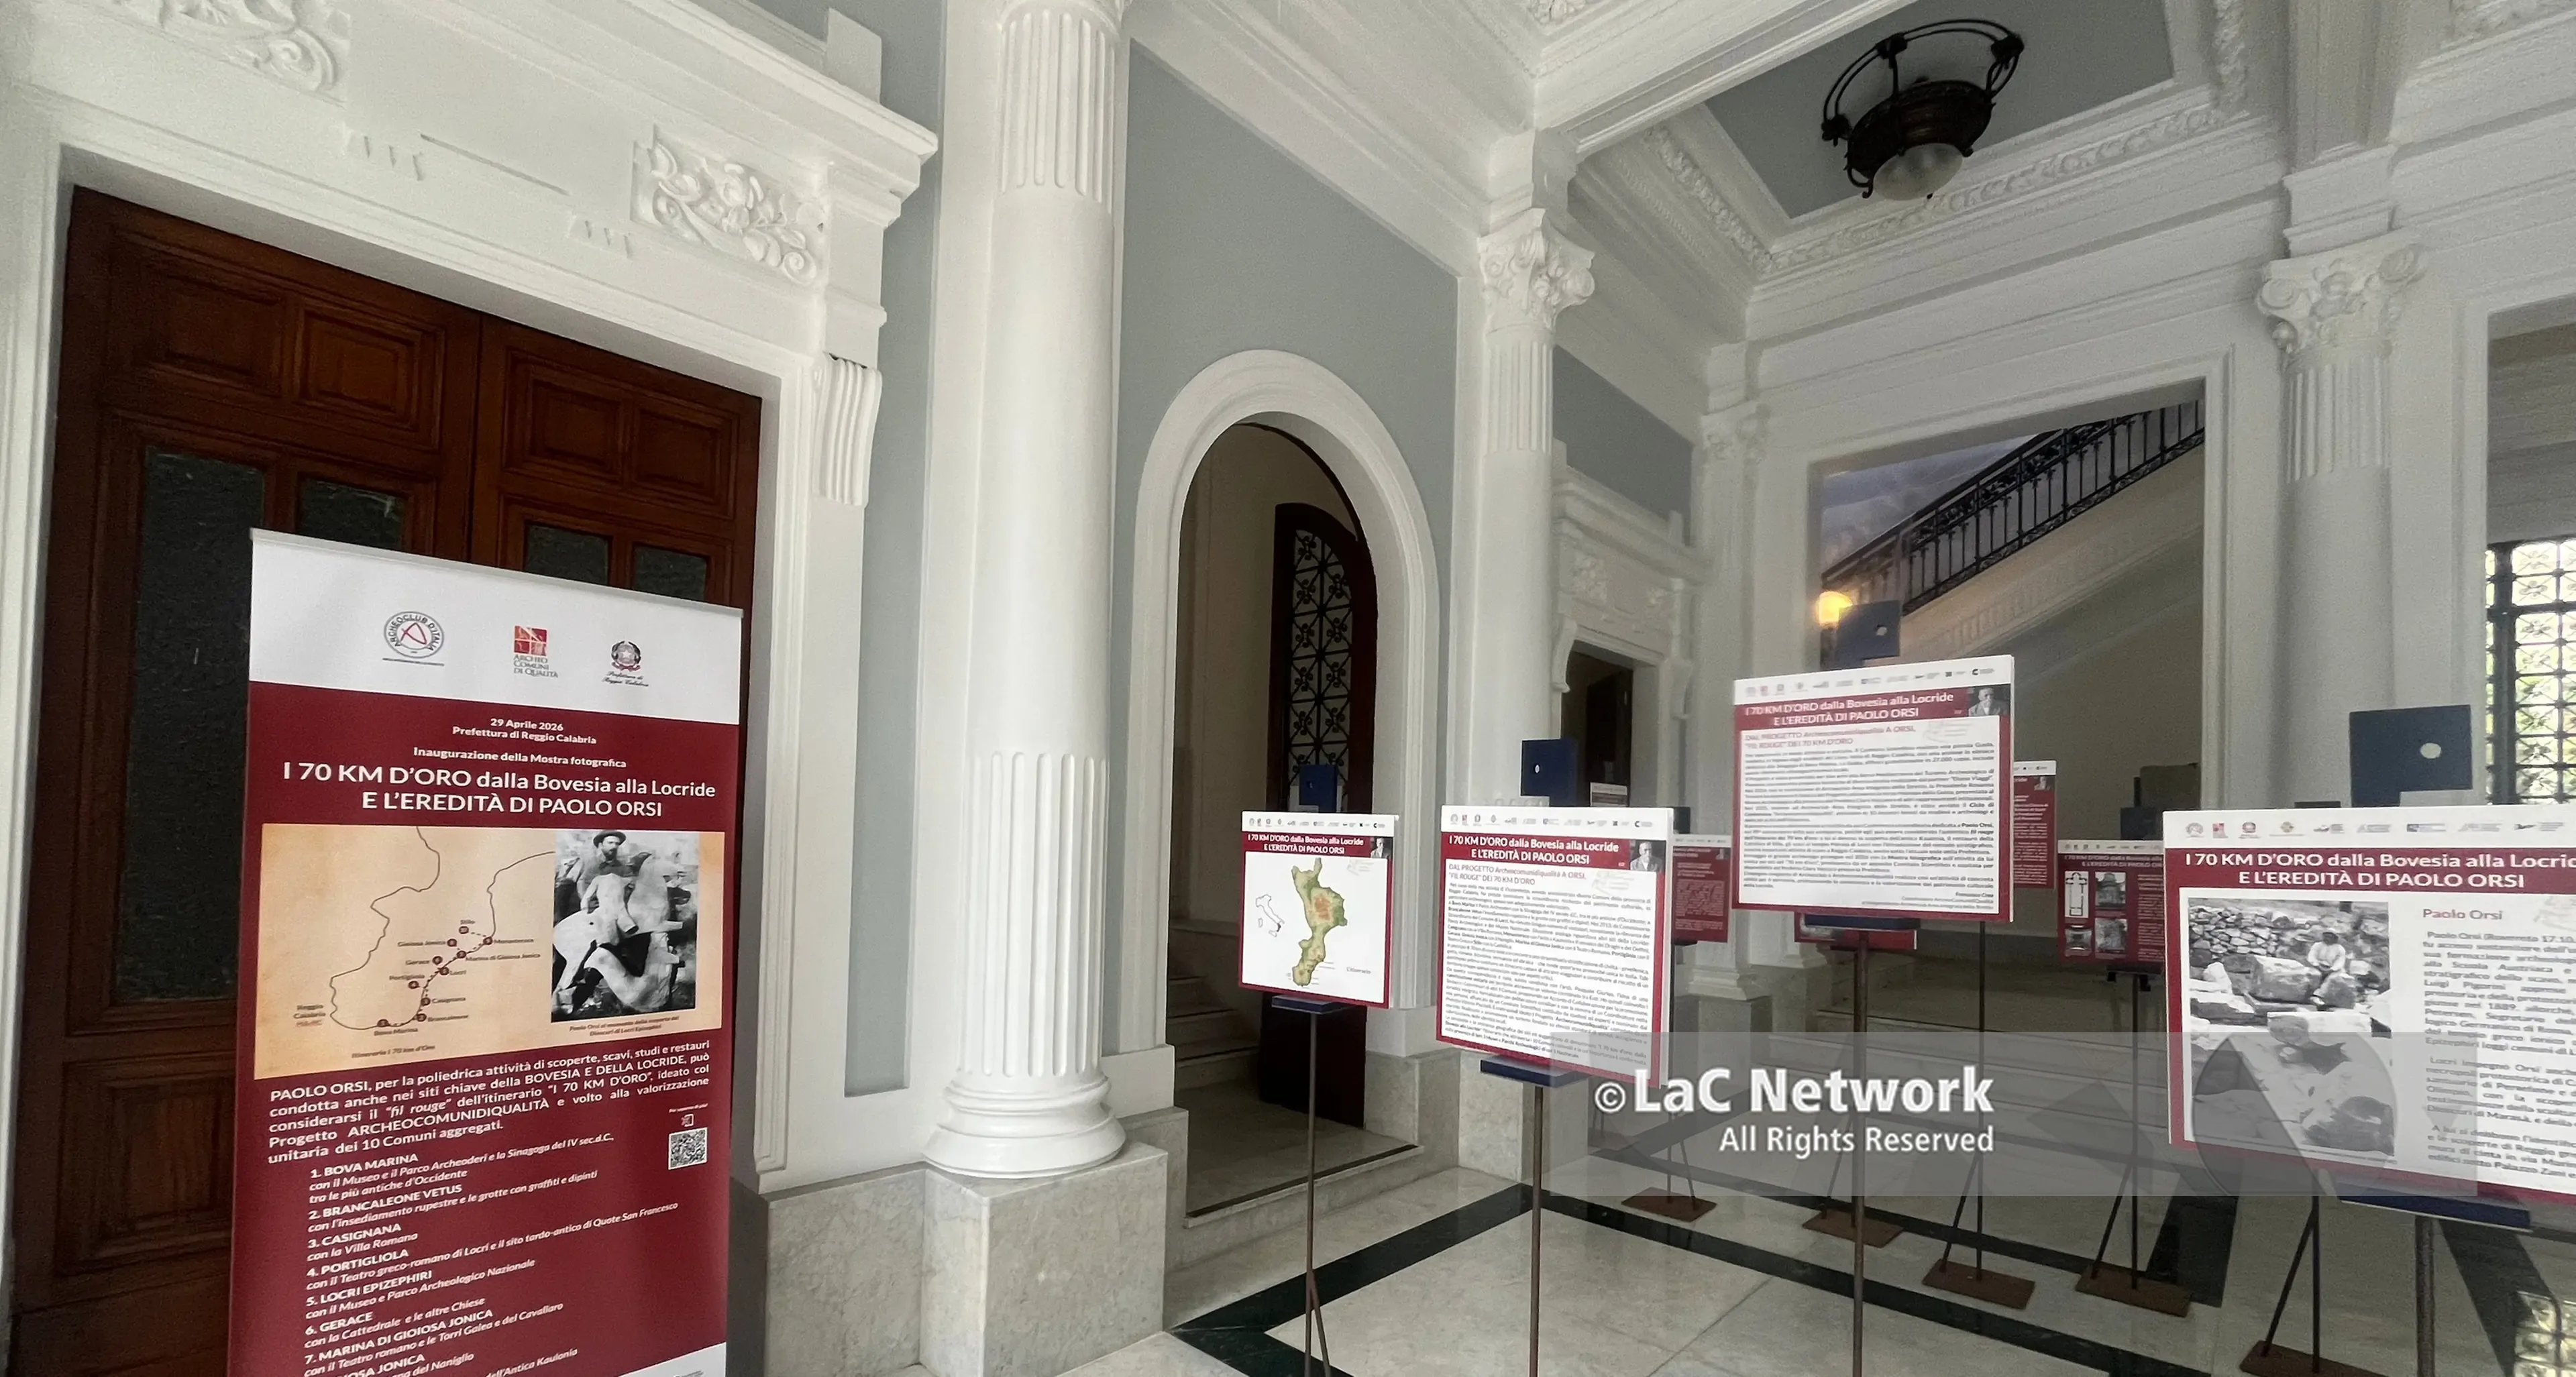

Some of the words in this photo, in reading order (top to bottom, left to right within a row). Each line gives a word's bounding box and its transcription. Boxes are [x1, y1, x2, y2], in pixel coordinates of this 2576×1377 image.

[490, 718, 504, 726] 29
[505, 720, 537, 729] Aprile
[539, 722, 564, 731] 2026
[1774, 717, 1780, 726] E
[1782, 712, 1834, 725] L'EREDITÀ
[1835, 713, 1847, 722] DI
[1849, 710, 1889, 720] PAOLO
[1890, 708, 1919, 718] ORSI
[452, 726, 508, 738] Prefettura
[509, 730, 519, 738] di
[521, 731, 555, 742] Reggio
[556, 734, 596, 744] Calabria
[414, 747, 498, 760] Inaugurazione
[500, 753, 528, 762] della
[530, 754, 569, 764] Mostra
[570, 757, 627, 767] fotografica
[284, 762, 290, 779] I
[299, 763, 331, 781] 70
[339, 765, 382, 783] KM
[390, 767, 472, 786] D'ORO
[476, 771, 528, 789] dalla
[534, 774, 610, 792] Bovesia
[615, 779, 647, 794] alla
[652, 780, 715, 797] Locride
[362, 791, 378, 808] E
[384, 792, 504, 812] L'EREDITÀ
[510, 797, 533, 813] DI
[539, 798, 612, 815] PAOLO
[616, 801, 661, 816] ORSI
[1269, 844, 1298, 852] L'EREDITÀ
[1306, 845, 1328, 854] PAOLO
[1449, 835, 1452, 844] I
[1454, 835, 1464, 844] 70
[1464, 836, 1479, 845] KM
[1480, 836, 1508, 846] D'ORO
[1509, 838, 1529, 848] dalla
[1531, 838, 1564, 849] Bovesia
[1566, 840, 1582, 850] alla
[1583, 841, 1619, 852] Locride
[1471, 848, 1477, 858] E
[1478, 849, 1519, 861] L'EREDITÀ
[1521, 851, 1532, 861] DI
[1532, 852, 1565, 863] PAOLO
[1566, 854, 1589, 864] ORSI
[2186, 853, 2190, 865] I
[2195, 853, 2218, 865] 70
[2222, 853, 2253, 866] KM
[2257, 853, 2323, 866] D'ORO
[2327, 853, 2375, 867] dalla
[2380, 854, 2461, 867] Bovesia
[2465, 854, 2504, 867] alla
[2239, 871, 2251, 883] E
[2254, 870, 2353, 885] L'EREDITÀ
[2358, 873, 2380, 885] DI
[2385, 873, 2463, 887] PAOLO
[2467, 874, 2524, 887] ORSI
[2423, 909, 2465, 919] Paolo
[2469, 910, 2503, 920] Orsi
[271, 1085, 327, 1101] PAOLO
[330, 1081, 372, 1094] ORSI,
[375, 1079, 399, 1091] per
[402, 1076, 414, 1086] la
[417, 1068, 483, 1086] poliedrica
[486, 1062, 531, 1076] attività
[533, 1059, 545, 1070] di
[547, 1055, 600, 1068] scoperte,
[602, 1050, 633, 1062] scavi,
[635, 1046, 660, 1058] studi
[670, 1040, 709, 1052] restauri
[270, 1101, 339, 1117] condotta
[344, 1095, 388, 1108] anche
[393, 1089, 413, 1101] nei
[419, 1086, 439, 1098] siti
[444, 1083, 486, 1095] chiave
[490, 1077, 521, 1089] della
[525, 1068, 580, 1084] BOVESIA
[585, 1066, 592, 1077] E
[596, 1062, 634, 1075] DELLA
[637, 1055, 687, 1070] LOCRIDE,
[690, 1052, 710, 1064] può
[269, 1111, 362, 1132] considerarsi
[370, 1109, 378, 1119] il
[457, 1088, 542, 1107] dell'itinerario
[563, 1082, 578, 1092] 70
[584, 1079, 604, 1089] KM
[658, 1068, 690, 1079] ideato
[694, 1064, 709, 1074] col
[269, 1131, 337, 1148] Progetto
[347, 1097, 549, 1138] ARCHEOCOMUNIDIQUALITÀ
[572, 1093, 602, 1104] volto
[610, 1089, 629, 1099] alla
[637, 1078, 709, 1095] valorizzazione
[268, 1146, 329, 1164] unitaria
[335, 1141, 358, 1154] dei
[362, 1138, 380, 1150] 10
[382, 1129, 436, 1146] Comuni
[439, 1119, 504, 1138] aggregati.
[324, 1163, 362, 1176] BOVA
[365, 1154, 418, 1170] MARINA
[323, 1191, 421, 1217] BRANCALEONE
[423, 1185, 462, 1199] VETUS
[321, 1223, 402, 1246] CASIGNANA
[321, 1249, 409, 1274] PORTIGLIOLA
[321, 1286, 360, 1304] LOCRI
[363, 1270, 432, 1295] EPIZEPHIRI
[319, 1311, 373, 1332] GERACE
[319, 1339, 375, 1361] MARINA
[377, 1335, 391, 1346] DI
[393, 1321, 446, 1341] GIOIOSA
[448, 1309, 493, 1327] JONICA
